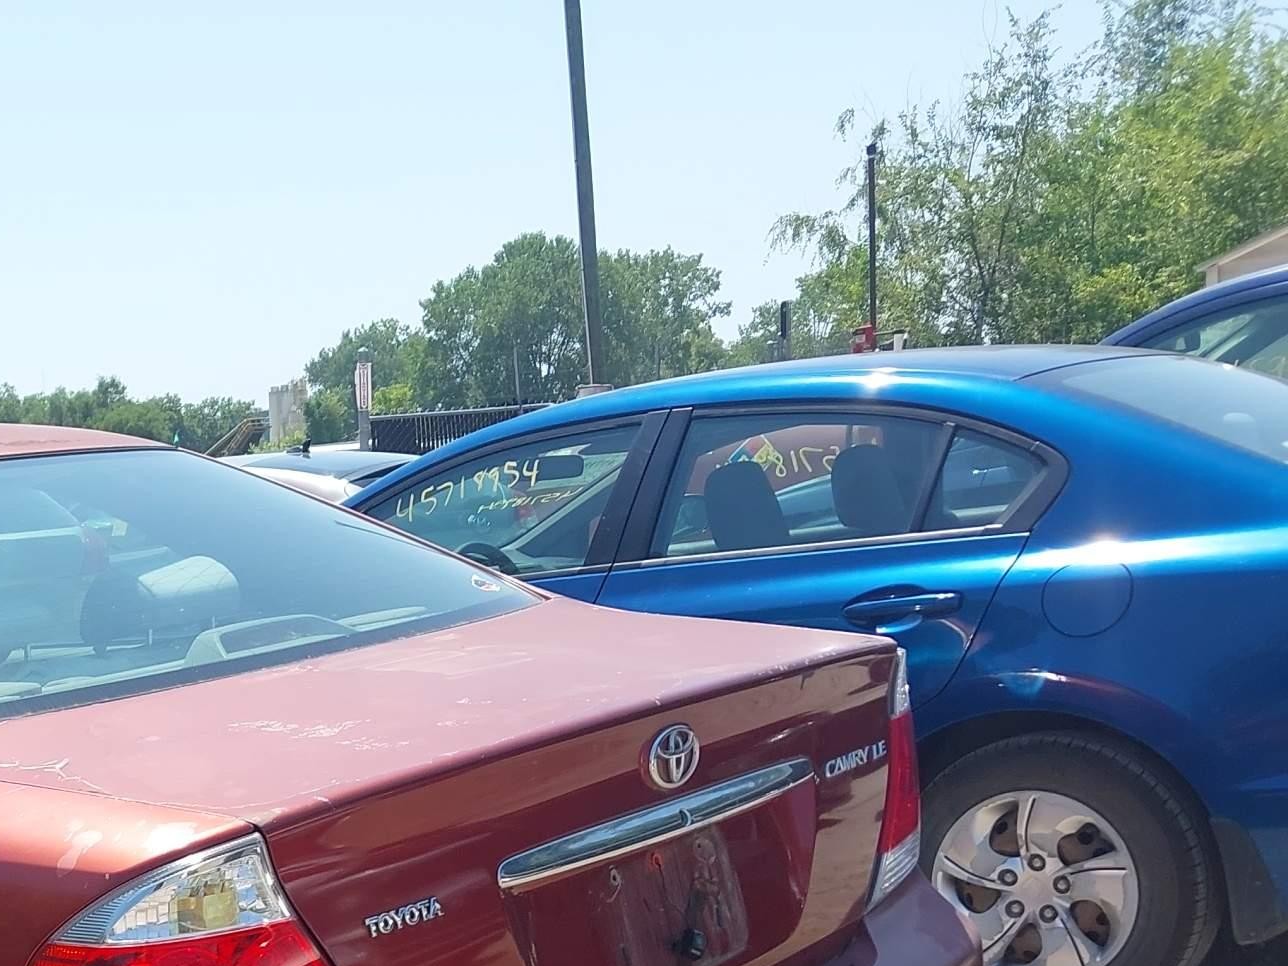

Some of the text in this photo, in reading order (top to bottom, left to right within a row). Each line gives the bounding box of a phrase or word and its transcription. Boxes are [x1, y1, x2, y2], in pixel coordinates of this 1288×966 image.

[396, 459, 540, 522] 45718954
[825, 739, 888, 778] CAMRY LE
[365, 896, 445, 938] TOYOTA
